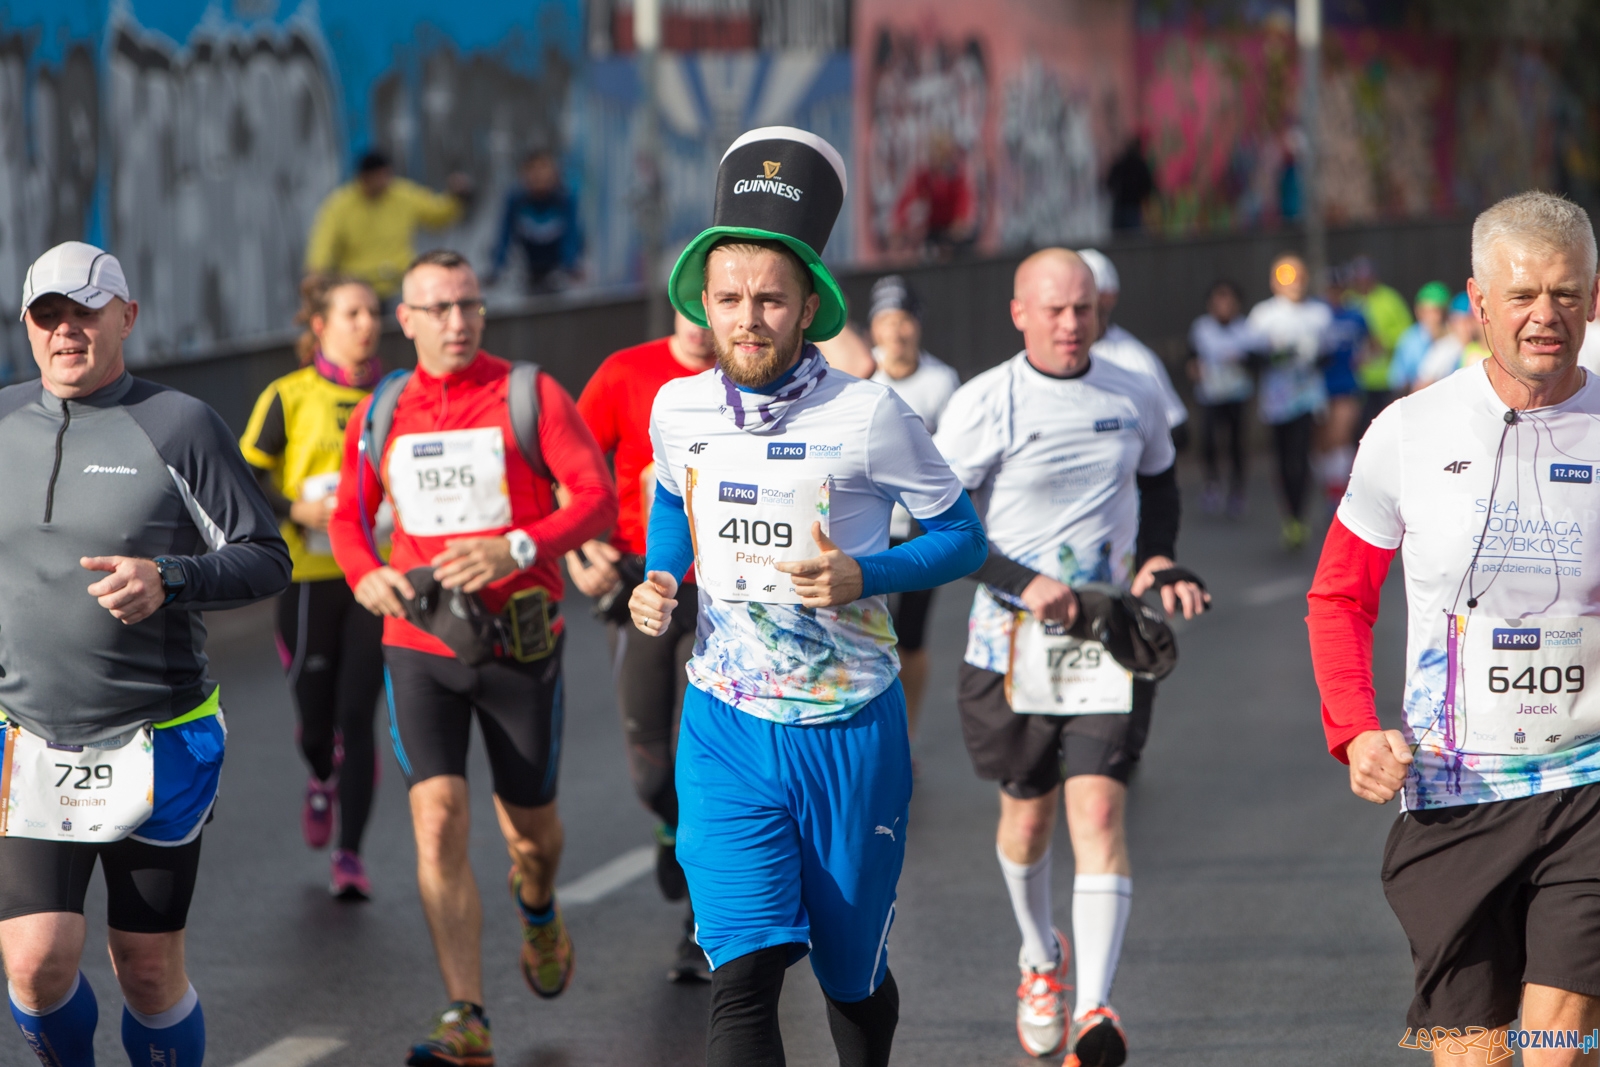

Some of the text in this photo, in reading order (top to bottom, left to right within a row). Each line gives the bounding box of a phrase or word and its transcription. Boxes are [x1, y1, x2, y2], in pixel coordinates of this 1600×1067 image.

[733, 179, 801, 202] GUINNESS
[688, 442, 708, 454] 4F
[1443, 461, 1472, 474] 4F
[416, 464, 475, 490] 1926
[718, 517, 792, 548] 4109
[1488, 517, 1583, 536] ODWAGA
[1472, 535, 1583, 555] SZYBKOŚĆ
[735, 551, 776, 567] Patryk
[1555, 567, 1582, 577] 2016
[762, 584, 777, 592] 4F
[1046, 647, 1100, 669] 1729
[1489, 665, 1585, 694] 6409
[1516, 703, 1558, 715] Jacek
[1545, 735, 1562, 743] 4F
[55, 763, 112, 789] 729
[60, 795, 106, 807] Damian
[88, 823, 103, 831] 4F
